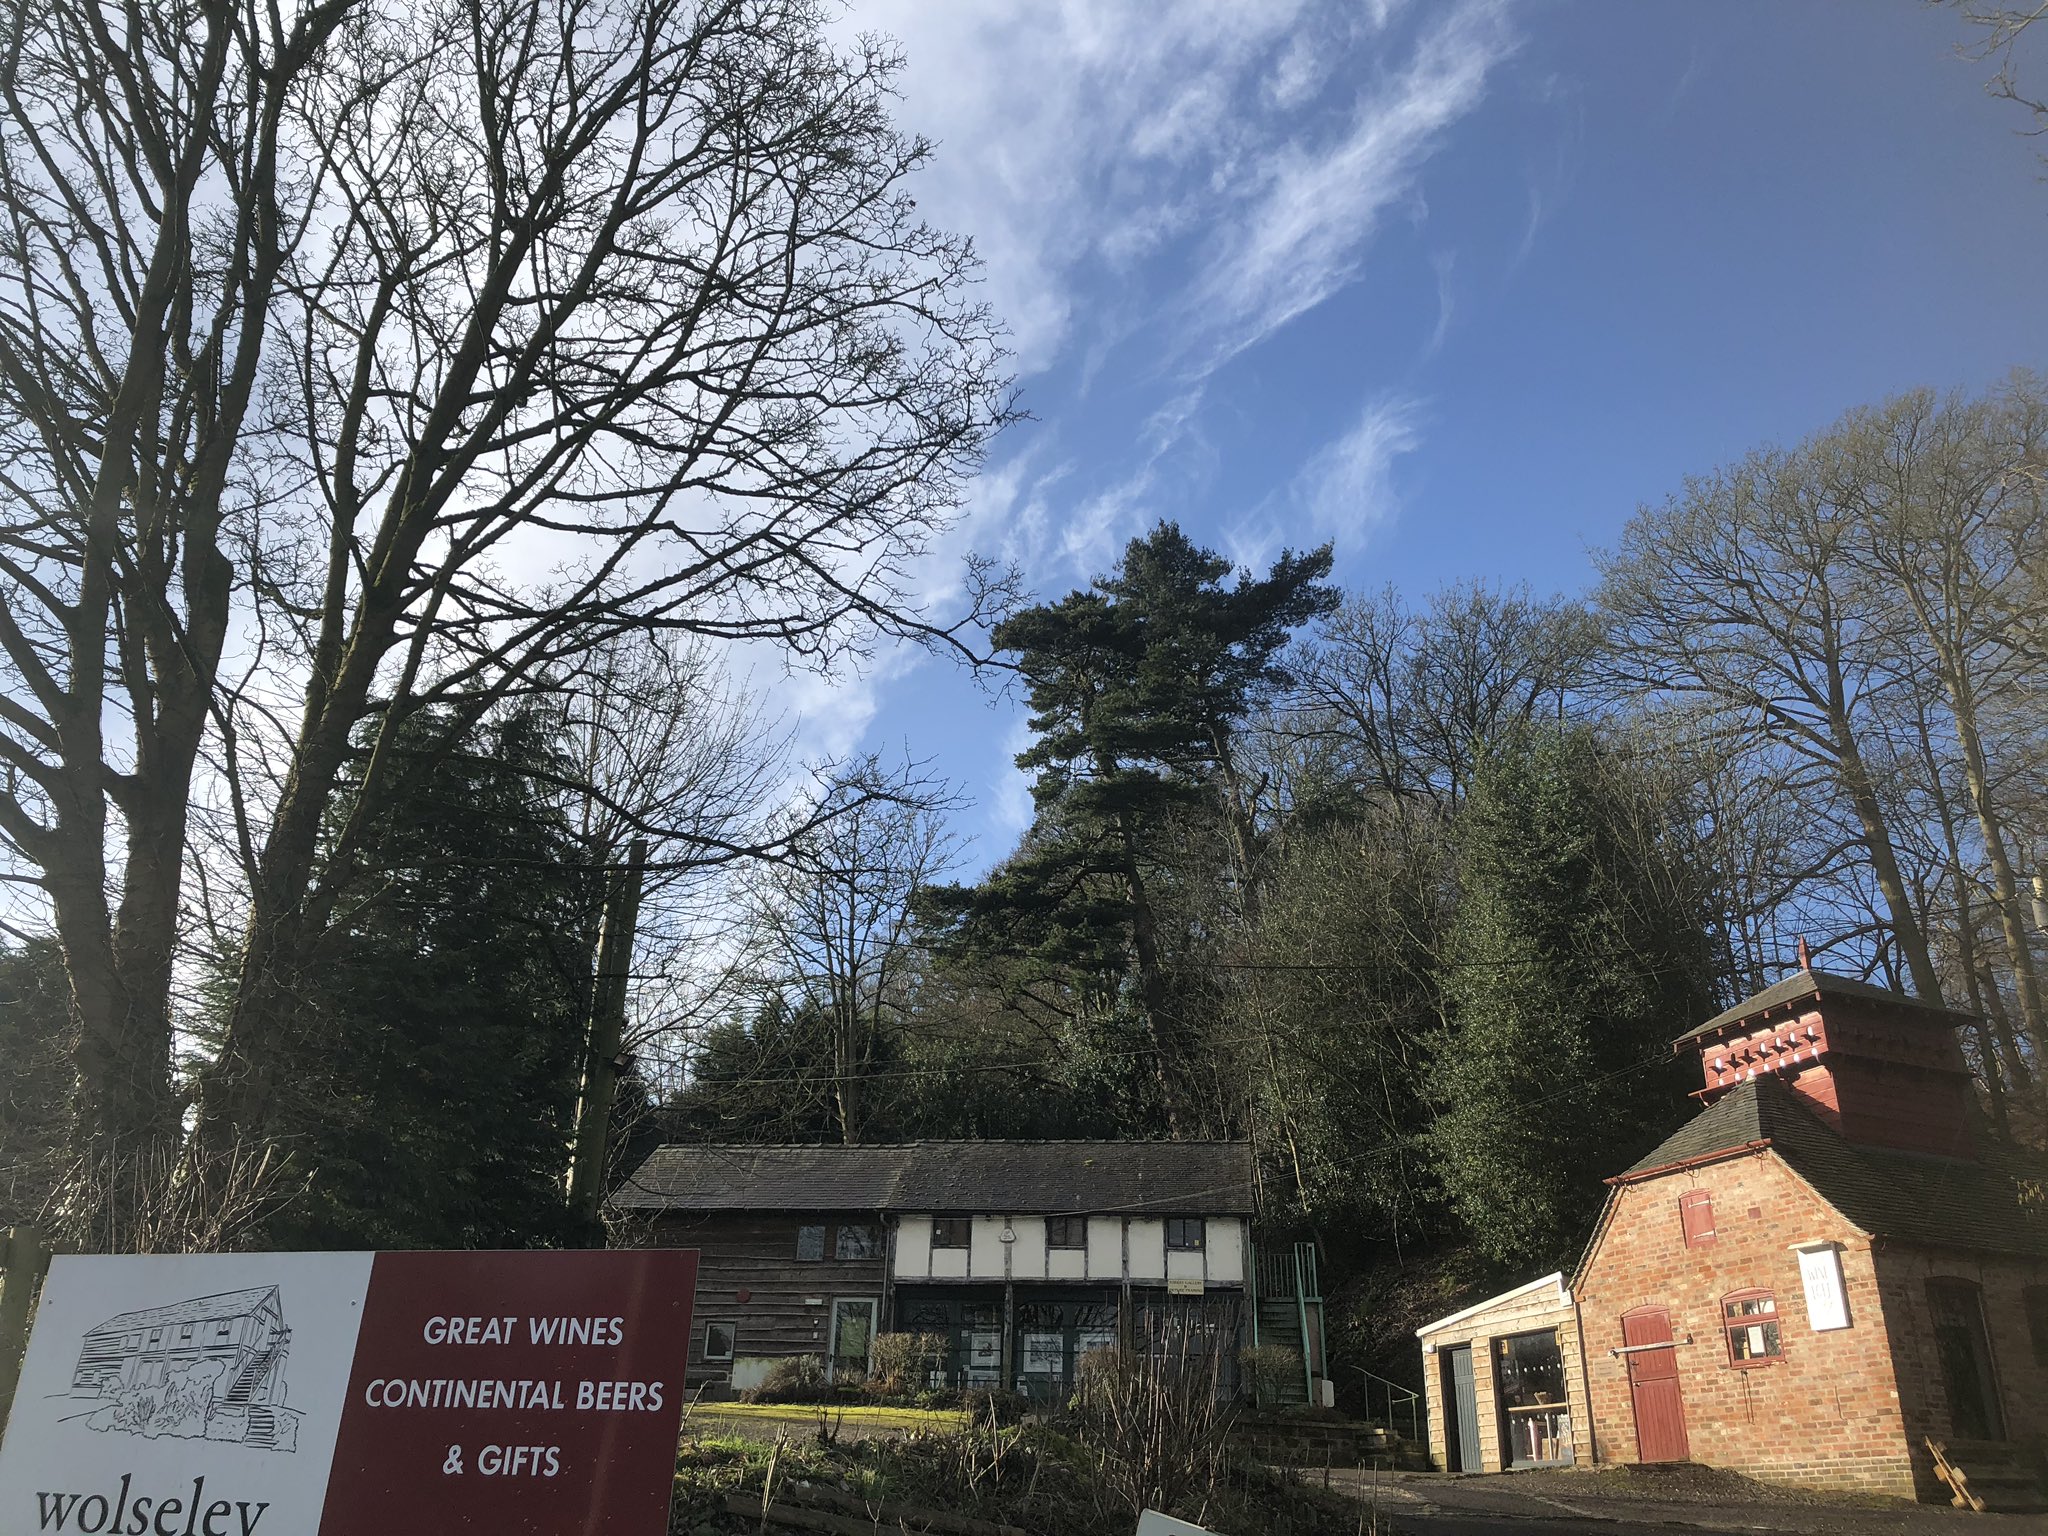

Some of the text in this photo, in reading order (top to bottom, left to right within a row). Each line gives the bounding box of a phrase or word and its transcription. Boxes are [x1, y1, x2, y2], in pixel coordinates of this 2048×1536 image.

[423, 1316, 624, 1345] GREAT WINES
[365, 1379, 664, 1411] CONTINENTAL BEERS
[442, 1445, 561, 1477] & GIFTS
[36, 1473, 270, 1536] wolseley
